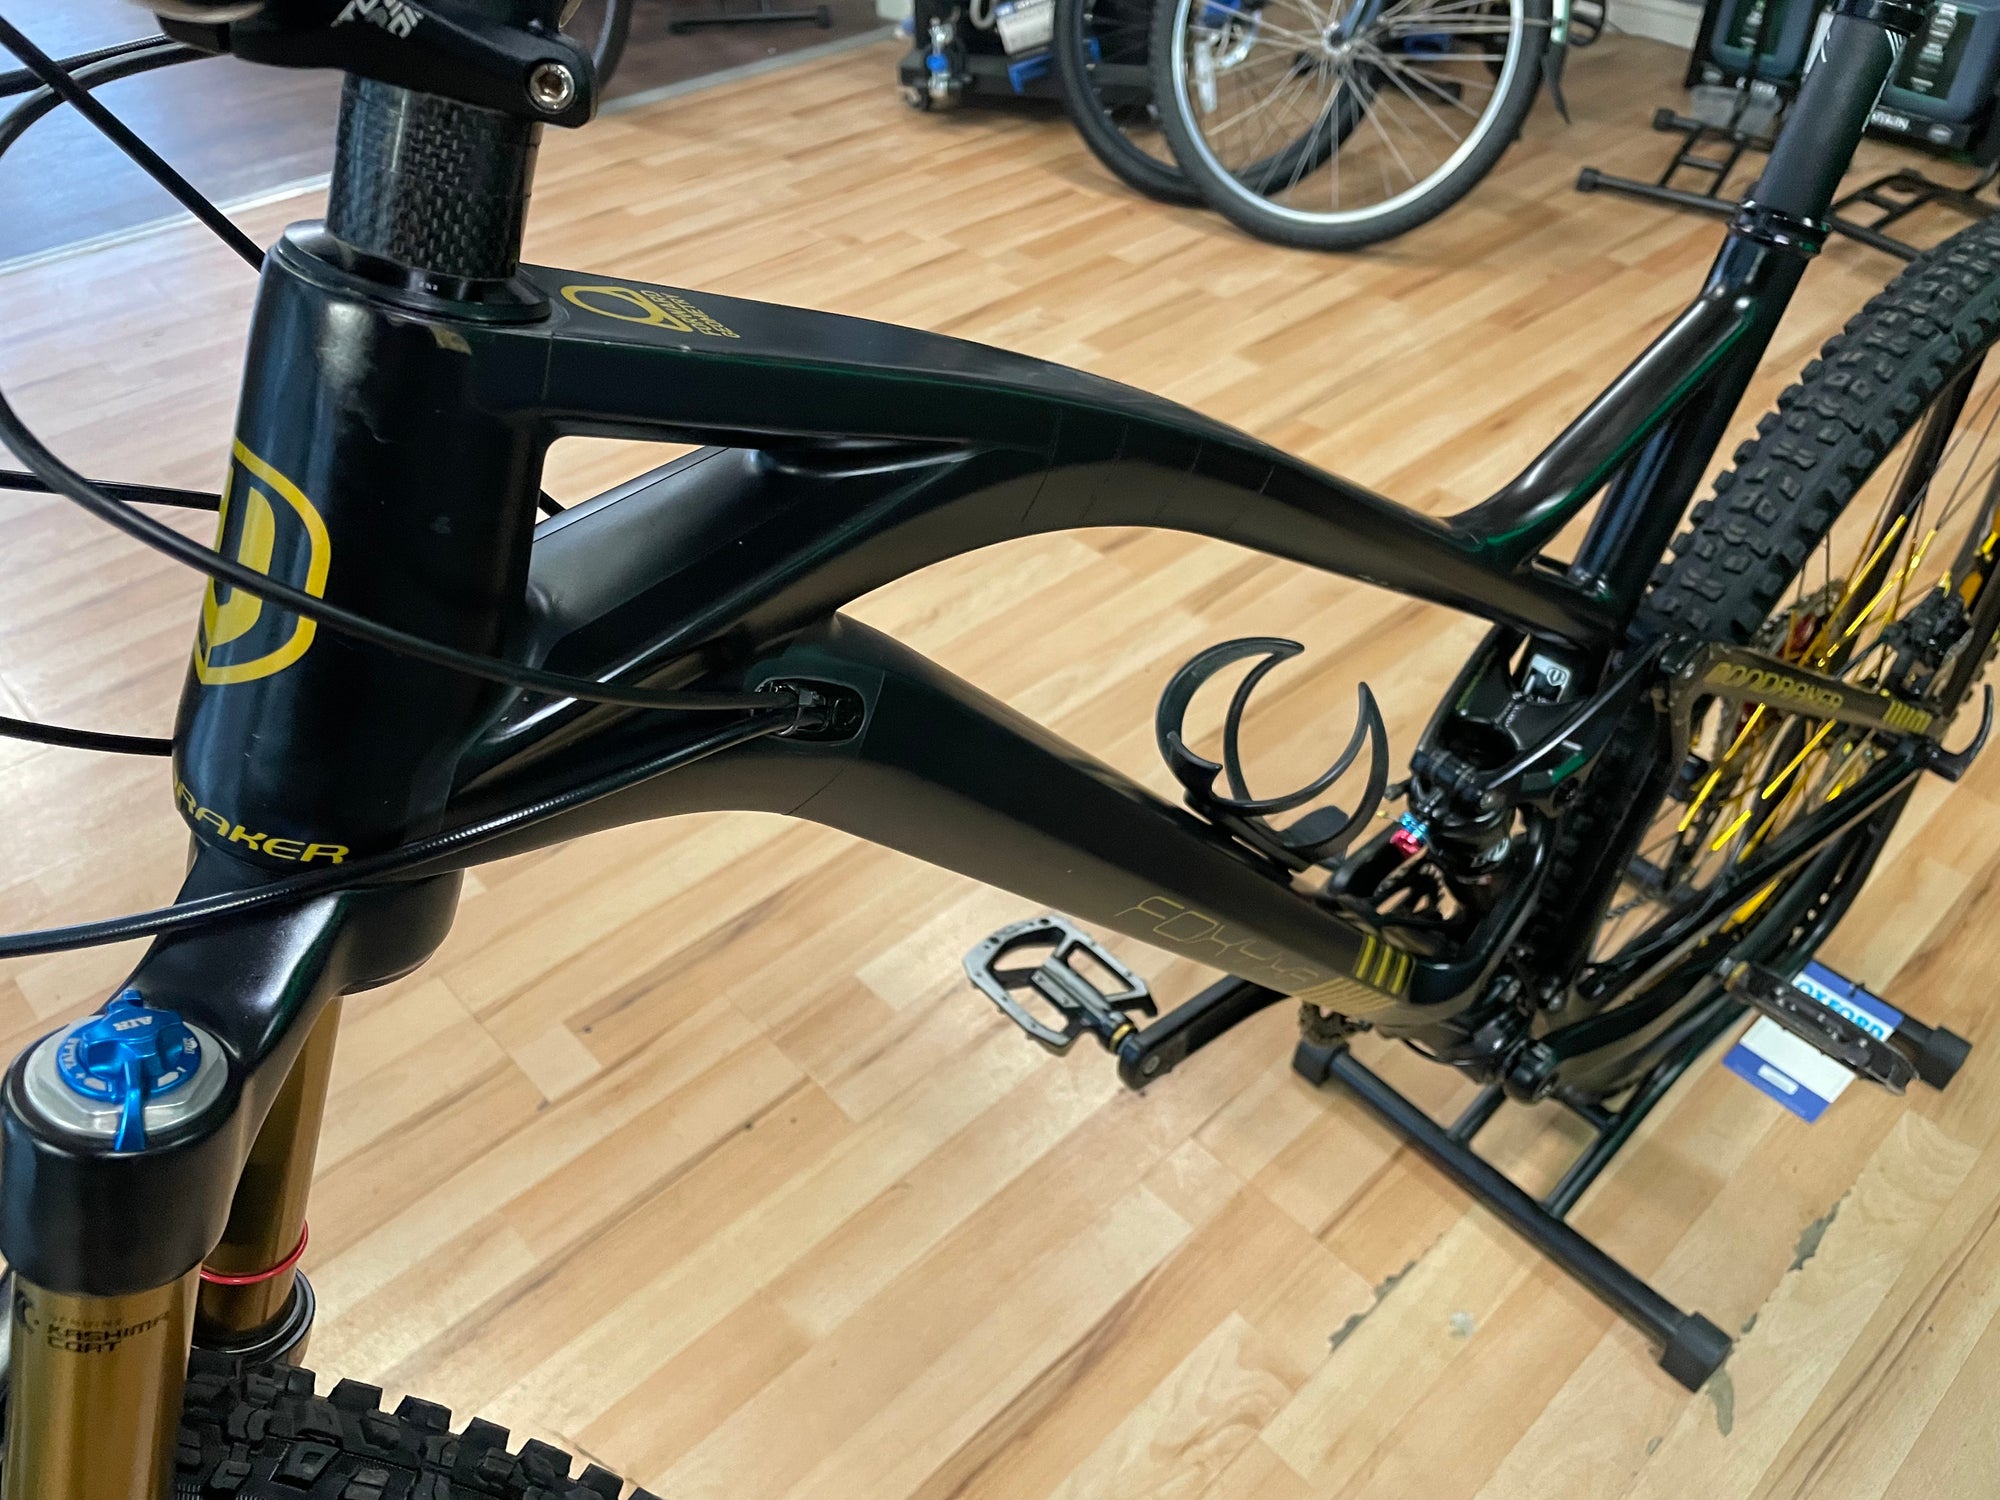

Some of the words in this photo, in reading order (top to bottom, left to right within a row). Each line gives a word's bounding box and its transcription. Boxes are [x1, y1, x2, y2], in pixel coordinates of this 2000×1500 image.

[640, 289, 723, 336] FORWARD
[113, 1016, 153, 1032] AIR
[48, 1336, 122, 1353] COAT
